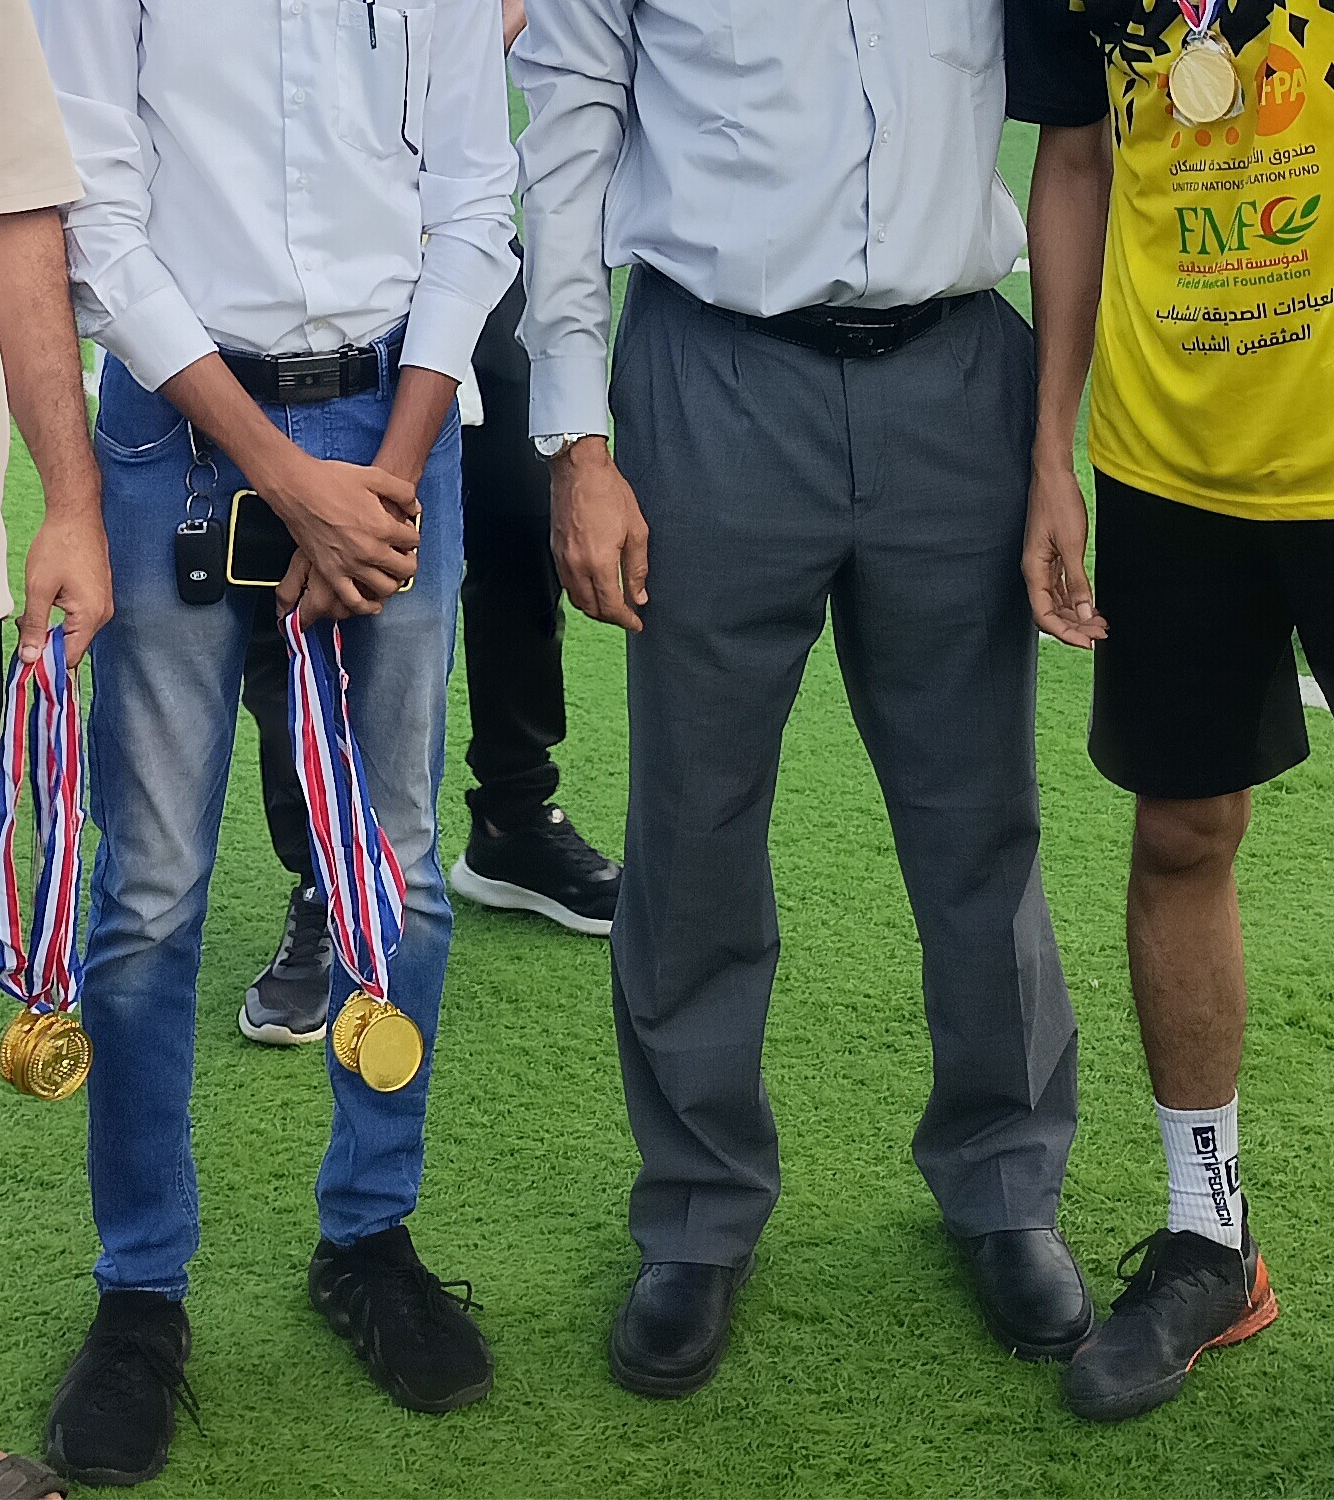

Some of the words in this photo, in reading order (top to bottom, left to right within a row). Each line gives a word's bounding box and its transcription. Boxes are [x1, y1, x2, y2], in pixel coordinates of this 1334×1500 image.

[1268, 143, 1316, 165] صندوق
[1288, 164, 1320, 178] FUND
[1245, 249, 1309, 269] المؤسسة
[1233, 267, 1311, 288] Foundation
[1156, 304, 1202, 325] للشباب
[1202, 302, 1268, 326] الصديقة
[1181, 334, 1230, 355] الشباب
[1236, 323, 1312, 356] المثقفين
